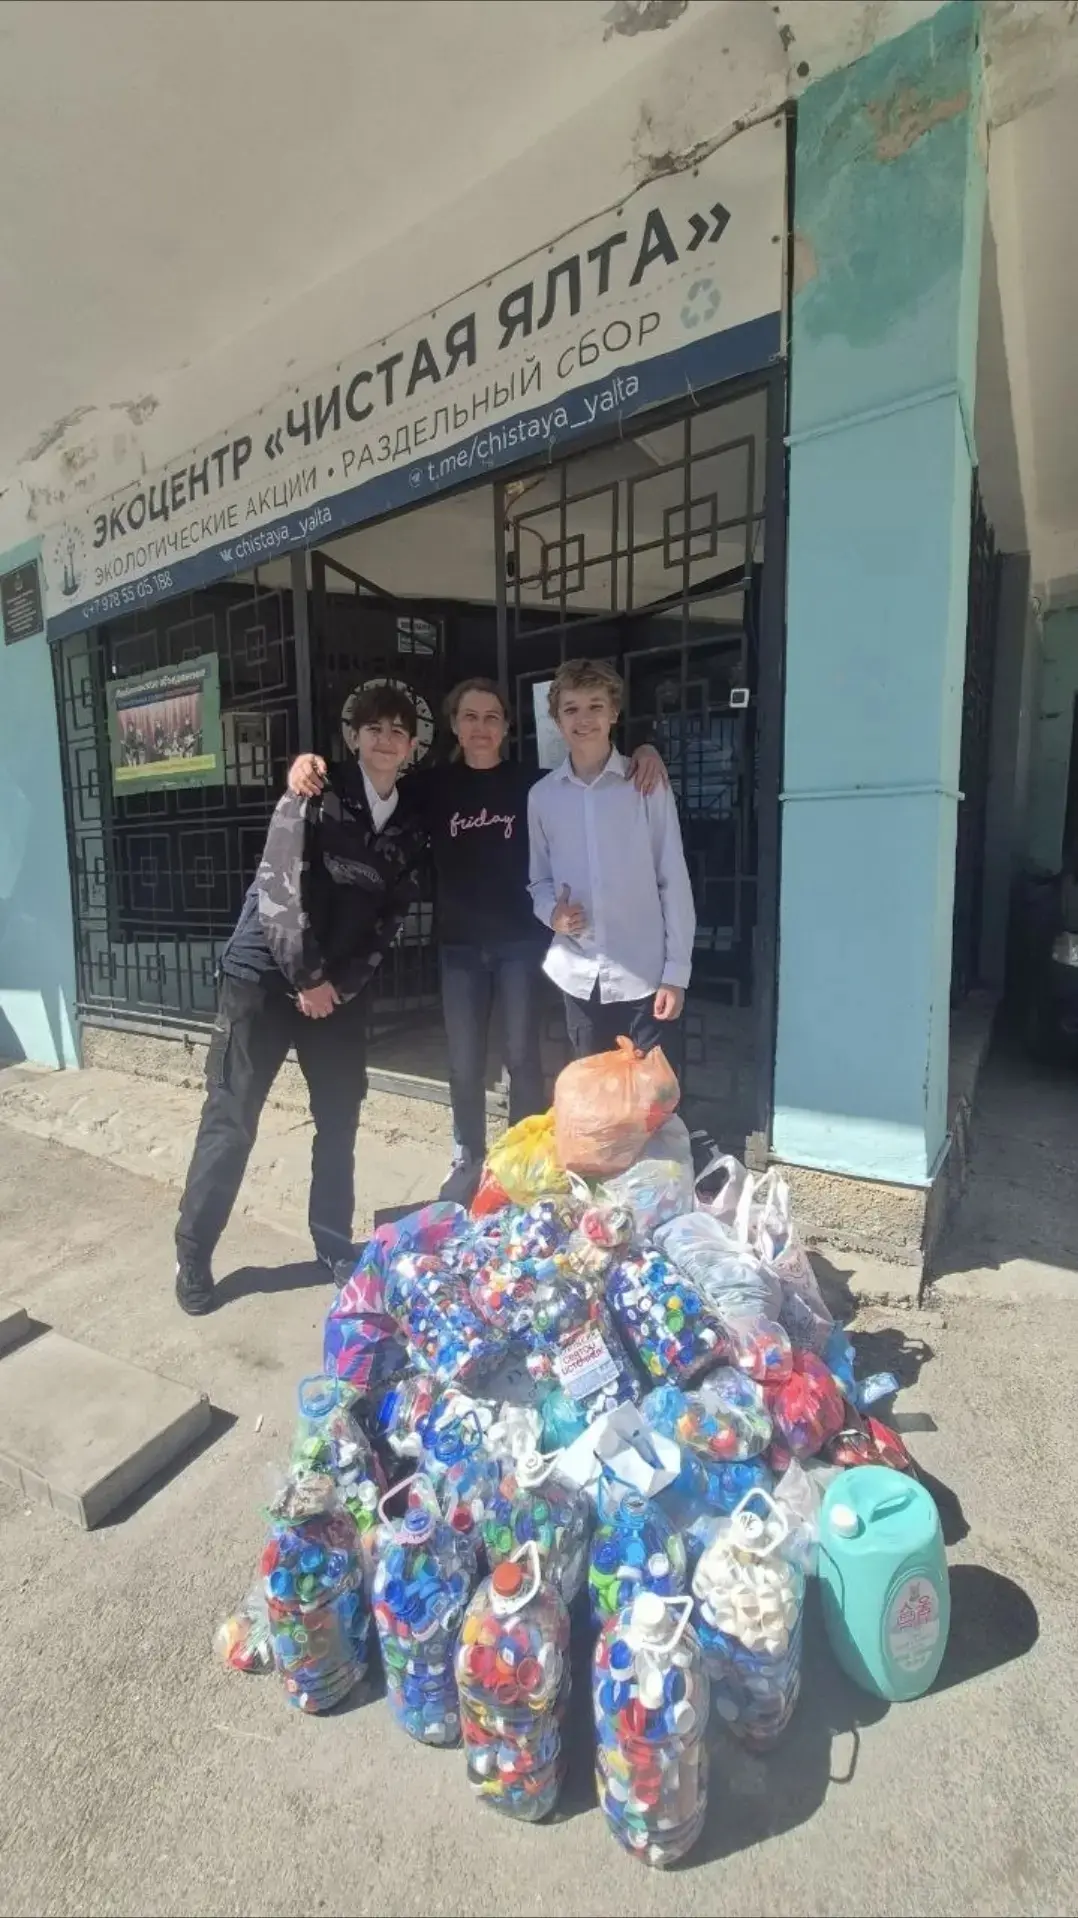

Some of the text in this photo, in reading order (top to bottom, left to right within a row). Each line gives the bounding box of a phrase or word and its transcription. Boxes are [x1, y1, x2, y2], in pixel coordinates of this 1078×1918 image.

[93, 202, 732, 548] ЭКОЦЕНТР «ЧИСТАЯ ЯЛТА»
[428, 374, 640, 482] t.me/chistaya_yalta
[95, 312, 661, 587] ЭКОЛОГИЧЕСКИЕ АКЦИИ РАЗДЕЛЬНЫЙ СБОР
[235, 506, 333, 559] chistaya_yalta
[450, 807, 516, 839] friday
